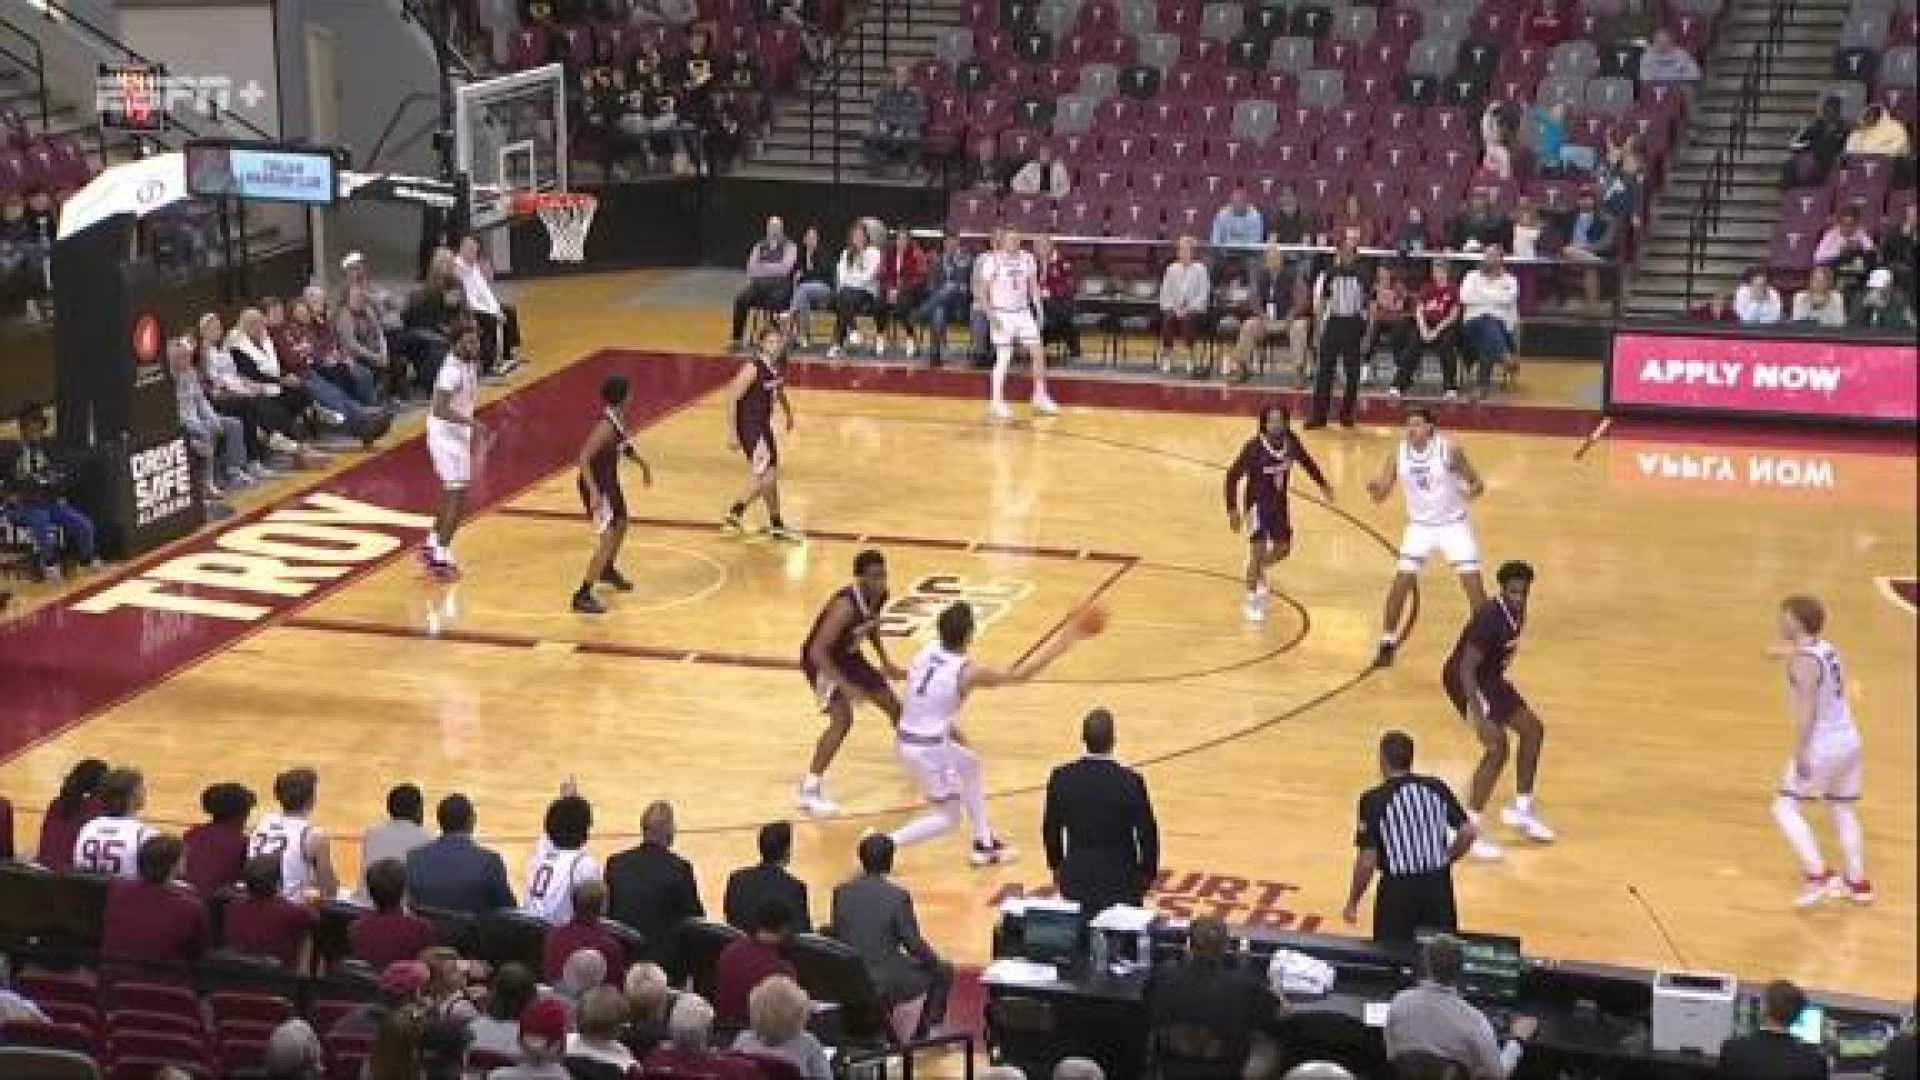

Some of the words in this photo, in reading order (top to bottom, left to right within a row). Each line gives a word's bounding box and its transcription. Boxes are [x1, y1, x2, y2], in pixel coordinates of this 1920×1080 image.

[1640, 359, 1743, 386] APPLY
[1753, 363, 1841, 391] NOW
[130, 440, 188, 480] DRIVE
[136, 470, 191, 507] SAFE
[70, 493, 436, 621] TROY
[83, 839, 127, 874] 95
[530, 863, 553, 897] 0
